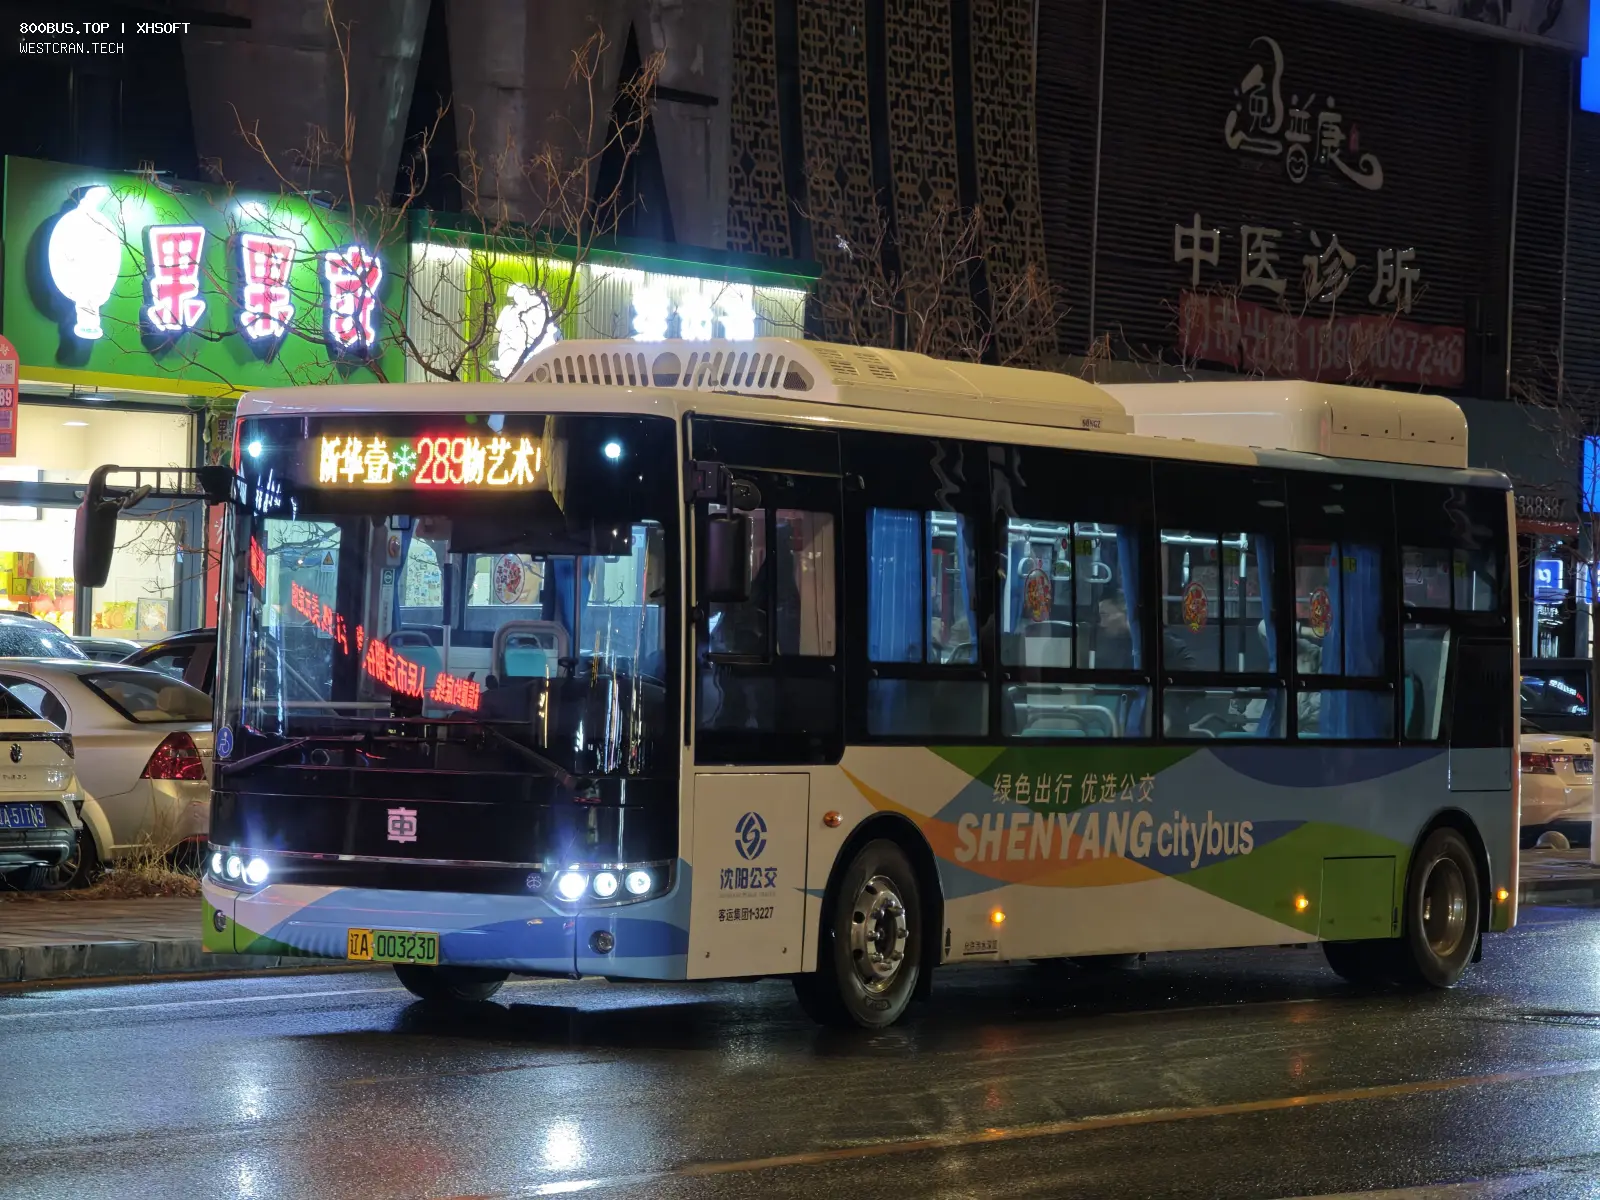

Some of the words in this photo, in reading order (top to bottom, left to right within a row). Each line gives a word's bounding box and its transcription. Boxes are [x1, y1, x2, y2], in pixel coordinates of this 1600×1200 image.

[1173, 212, 1421, 314] 中医诊所
[415, 436, 466, 484] 289
[992, 772, 1073, 805] 绿色出行
[1081, 772, 1155, 803] 优选公交
[954, 811, 1154, 863] SHENYANG
[1157, 810, 1254, 869] citybus
[720, 867, 778, 890] 沈阳公交
